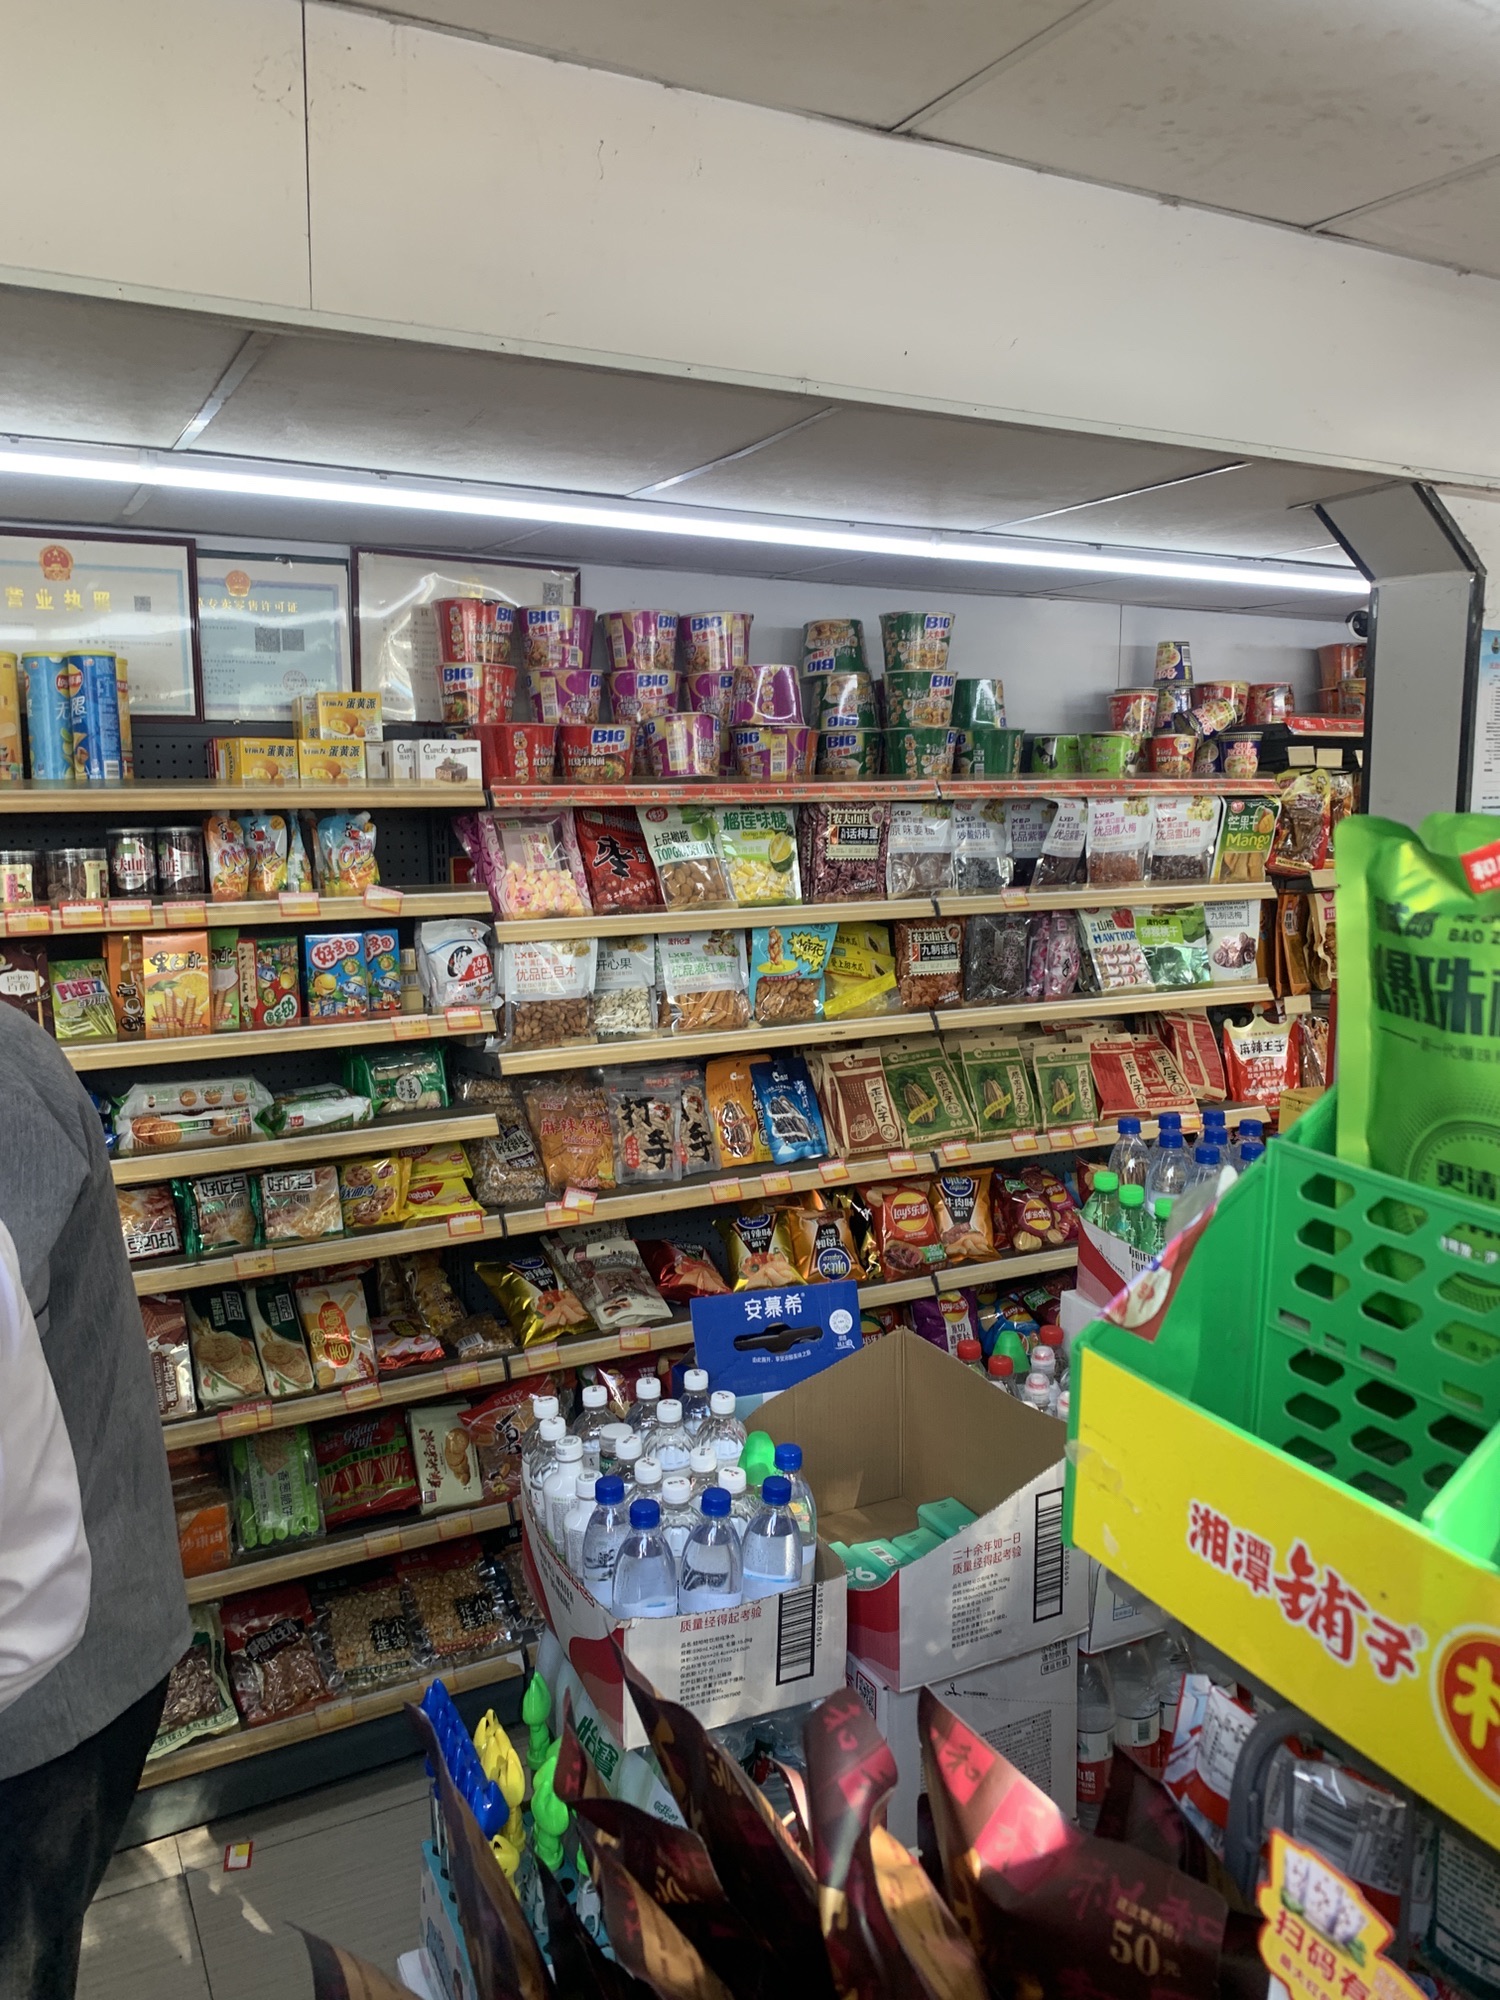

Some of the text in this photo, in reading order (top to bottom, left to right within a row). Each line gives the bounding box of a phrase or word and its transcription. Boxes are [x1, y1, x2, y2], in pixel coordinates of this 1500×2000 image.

[5, 588, 112, 612] 营业执照
[529, 611, 560, 624] BIG
[444, 668, 473, 681] BIG
[637, 674, 668, 687] BIG
[346, 697, 377, 710] 蛋黄派
[592, 730, 625, 744] BIG
[827, 735, 856, 748] BIG
[267, 744, 295, 758] 蛋黄派
[328, 744, 361, 758] 蛋黄派
[723, 811, 788, 831] 榴莲味糖
[1228, 815, 1259, 832] 芒果干
[1226, 833, 1270, 850] Mango
[1470, 855, 1500, 881] 和
[1211, 911, 1243, 921] 九制话梅
[1093, 930, 1137, 944] HAWTHOR
[921, 944, 957, 956] 九制话梅
[57, 979, 105, 1002] PRETZ
[1374, 943, 1500, 1037] 爆珠
[1239, 1039, 1285, 1056] 麻辣王子
[541, 1117, 613, 1137] 麻辣锅巴
[199, 1175, 247, 1198] 好吃点
[266, 1173, 315, 1193] 好吃点
[945, 1197, 975, 1208] 牛肉味
[744, 1292, 803, 1321] 安慕希
[343, 1422, 380, 1445] Golden
[952, 1531, 1022, 1561] 二十余年如一日
[951, 1545, 1022, 1576] 质量经得起考验
[1189, 1504, 1416, 1678] 湘潭铺子
[680, 1605, 763, 1633] 质量经得起考验
